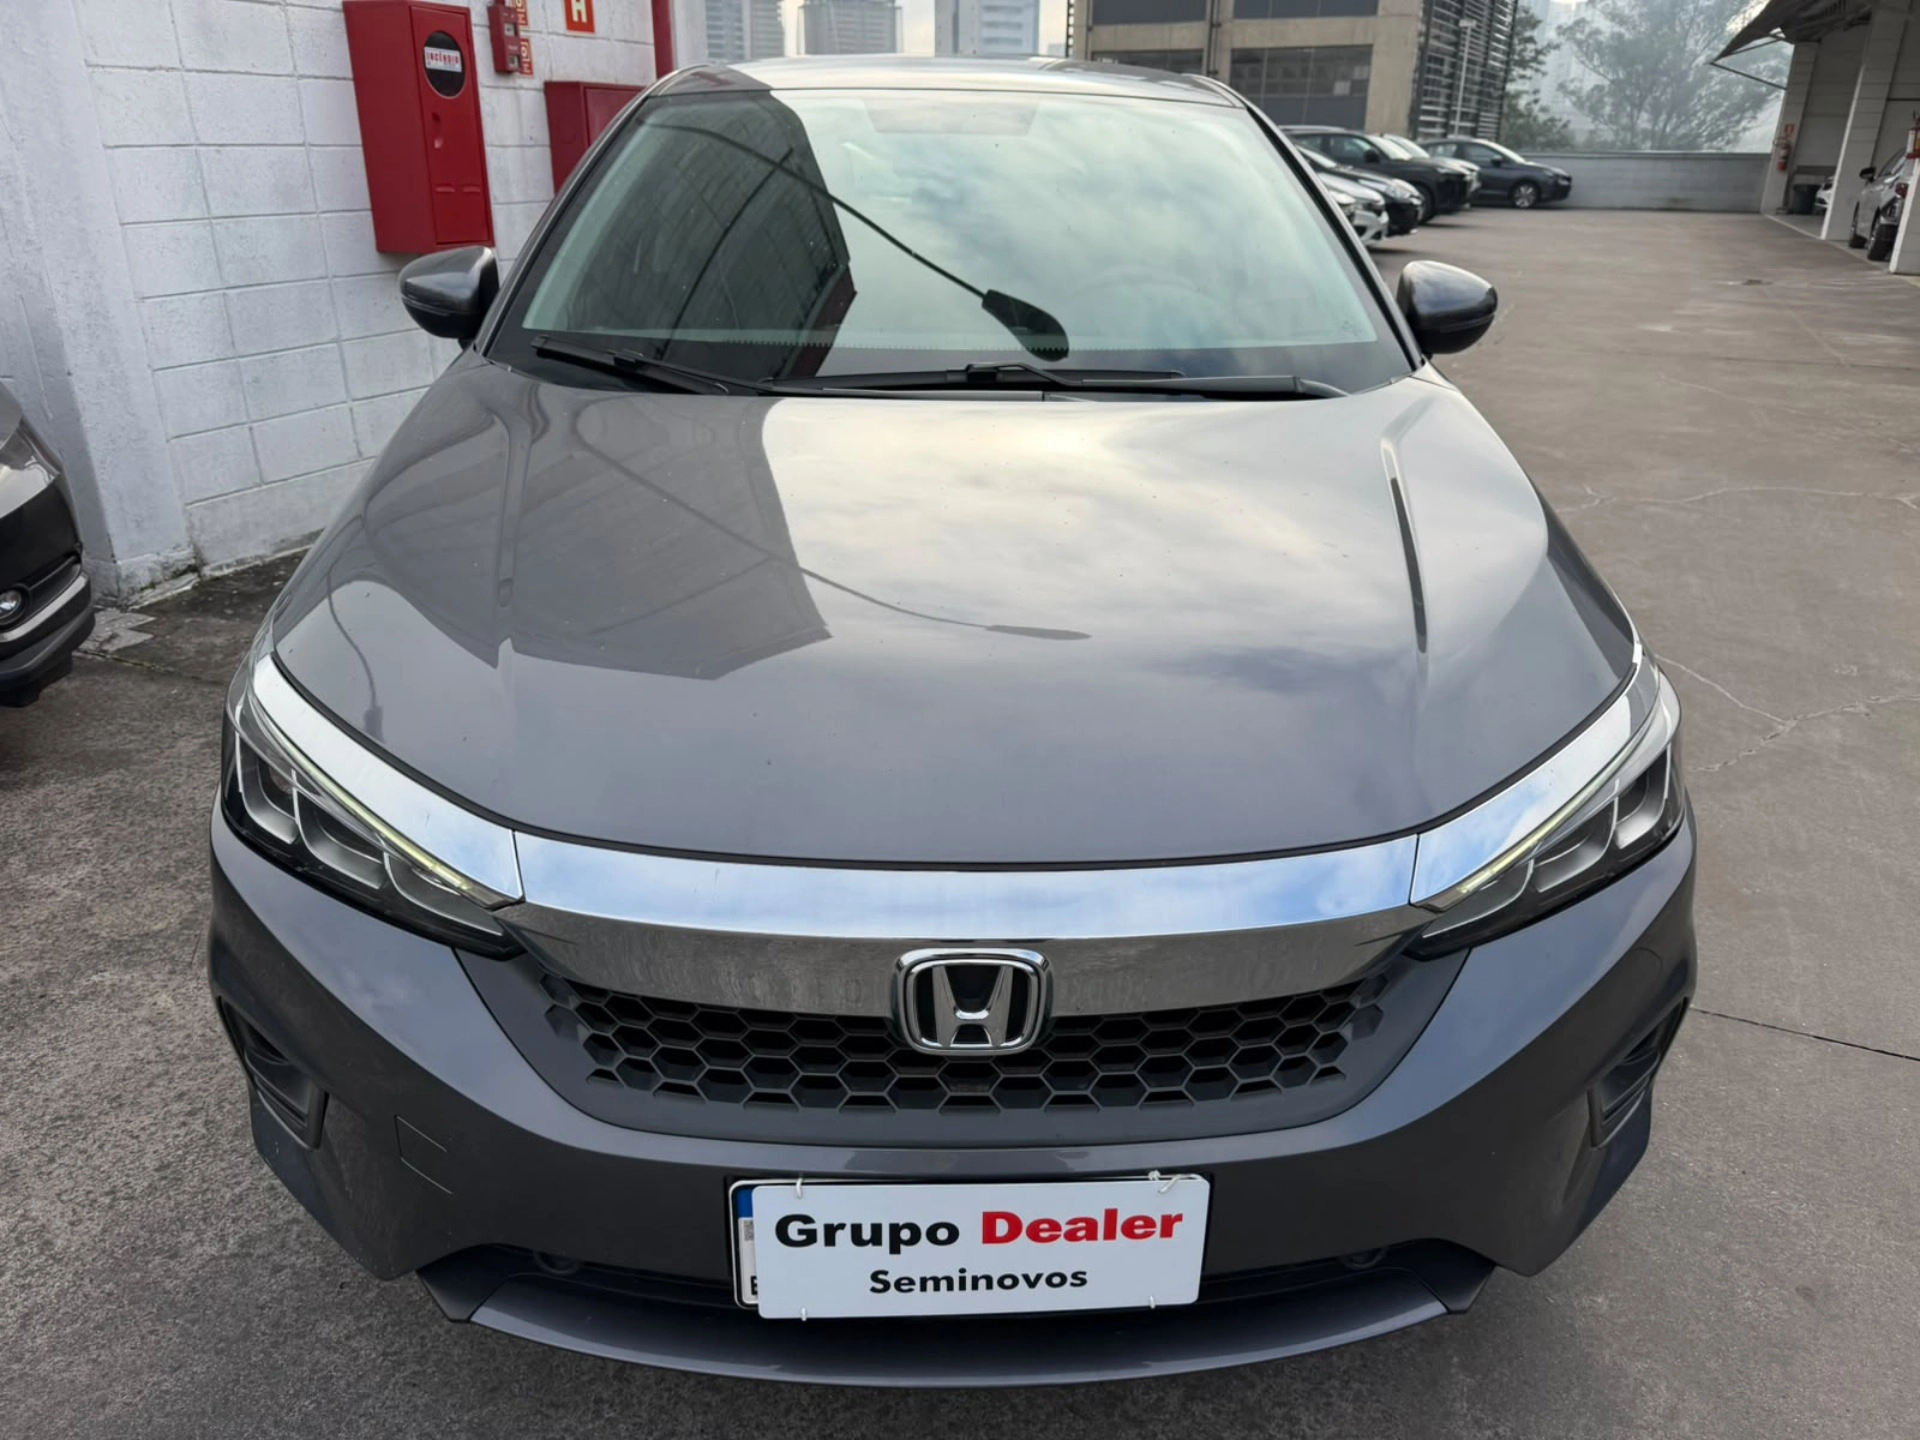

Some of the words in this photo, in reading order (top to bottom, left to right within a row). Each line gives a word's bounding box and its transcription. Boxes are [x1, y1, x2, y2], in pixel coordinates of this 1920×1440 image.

[775, 1213, 960, 1255] Grupo
[982, 1208, 1183, 1245] Dealer
[869, 1267, 1088, 1294] Seminovos
